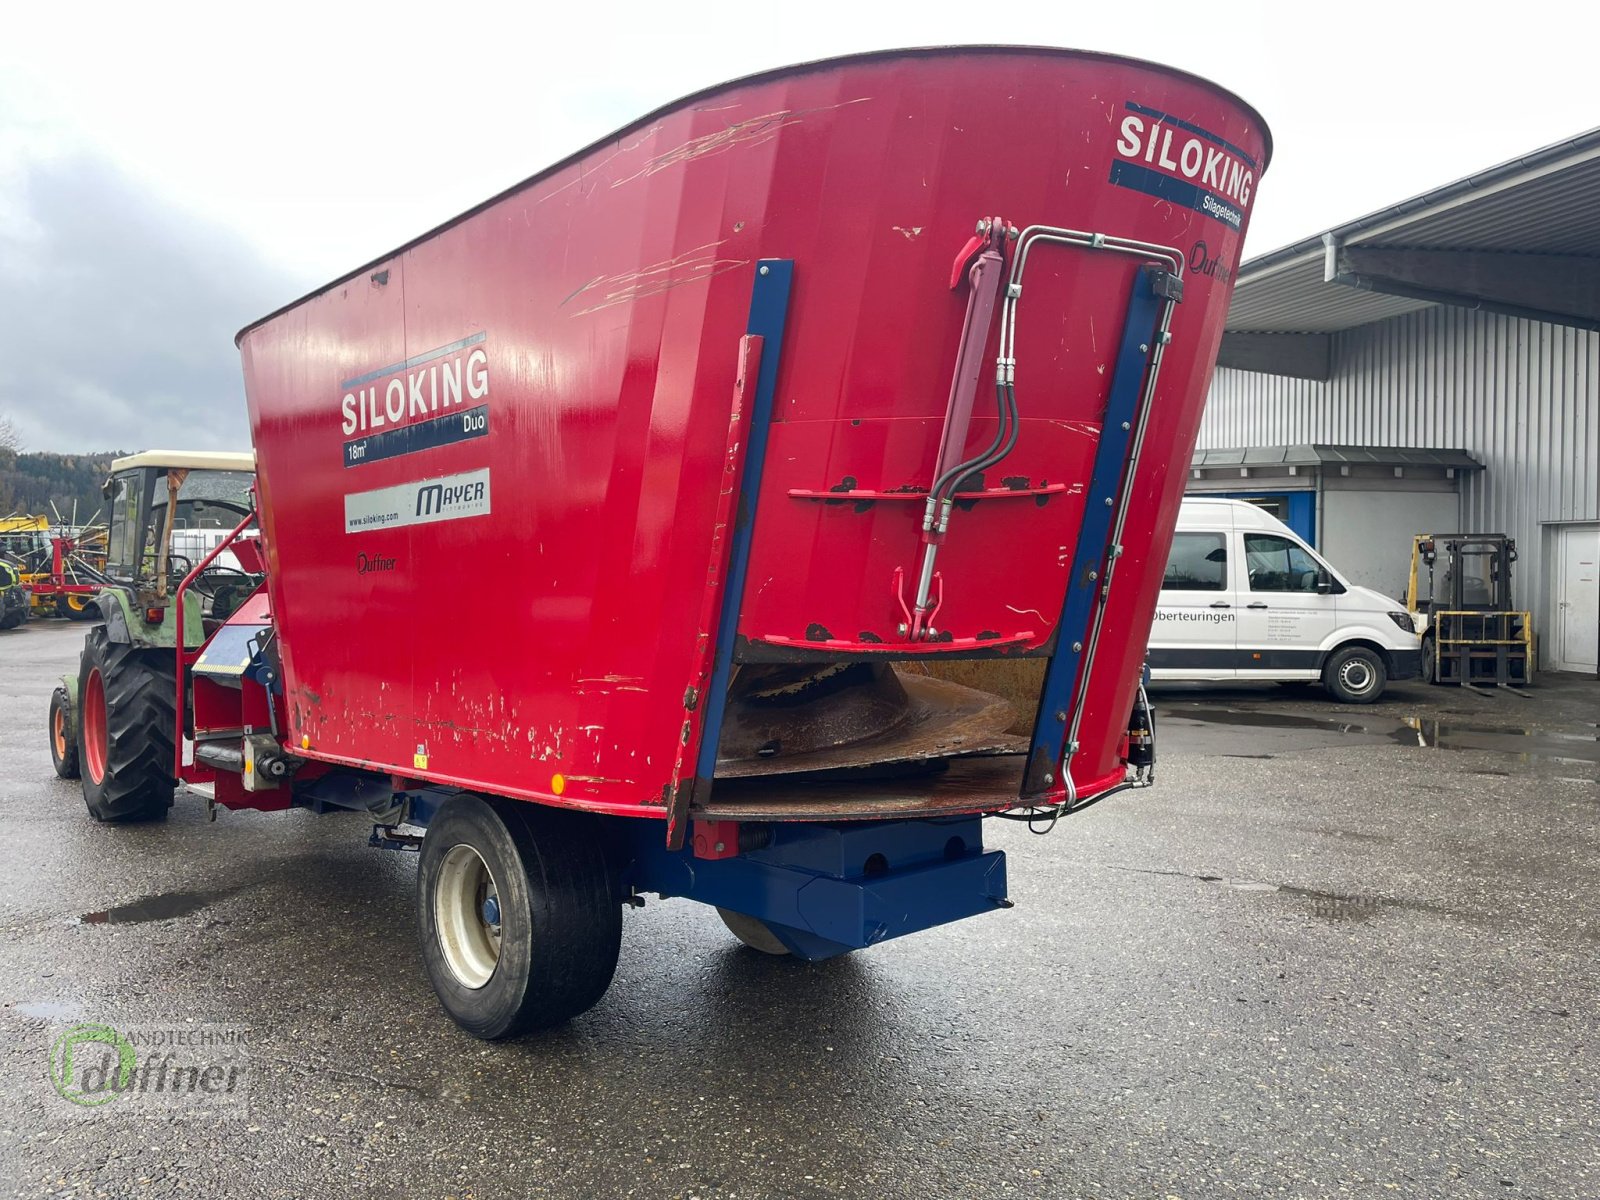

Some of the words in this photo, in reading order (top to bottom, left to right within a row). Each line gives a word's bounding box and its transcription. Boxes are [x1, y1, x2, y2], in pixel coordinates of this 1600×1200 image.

[1117, 115, 1253, 208] SILOKING
[1202, 195, 1242, 228] Silagetechnik
[341, 349, 489, 436] SILOKING
[463, 415, 485, 433] Duo
[415, 482, 485, 517] MAYER
[348, 512, 399, 527] www.siloking.com
[356, 551, 396, 576] Duffner
